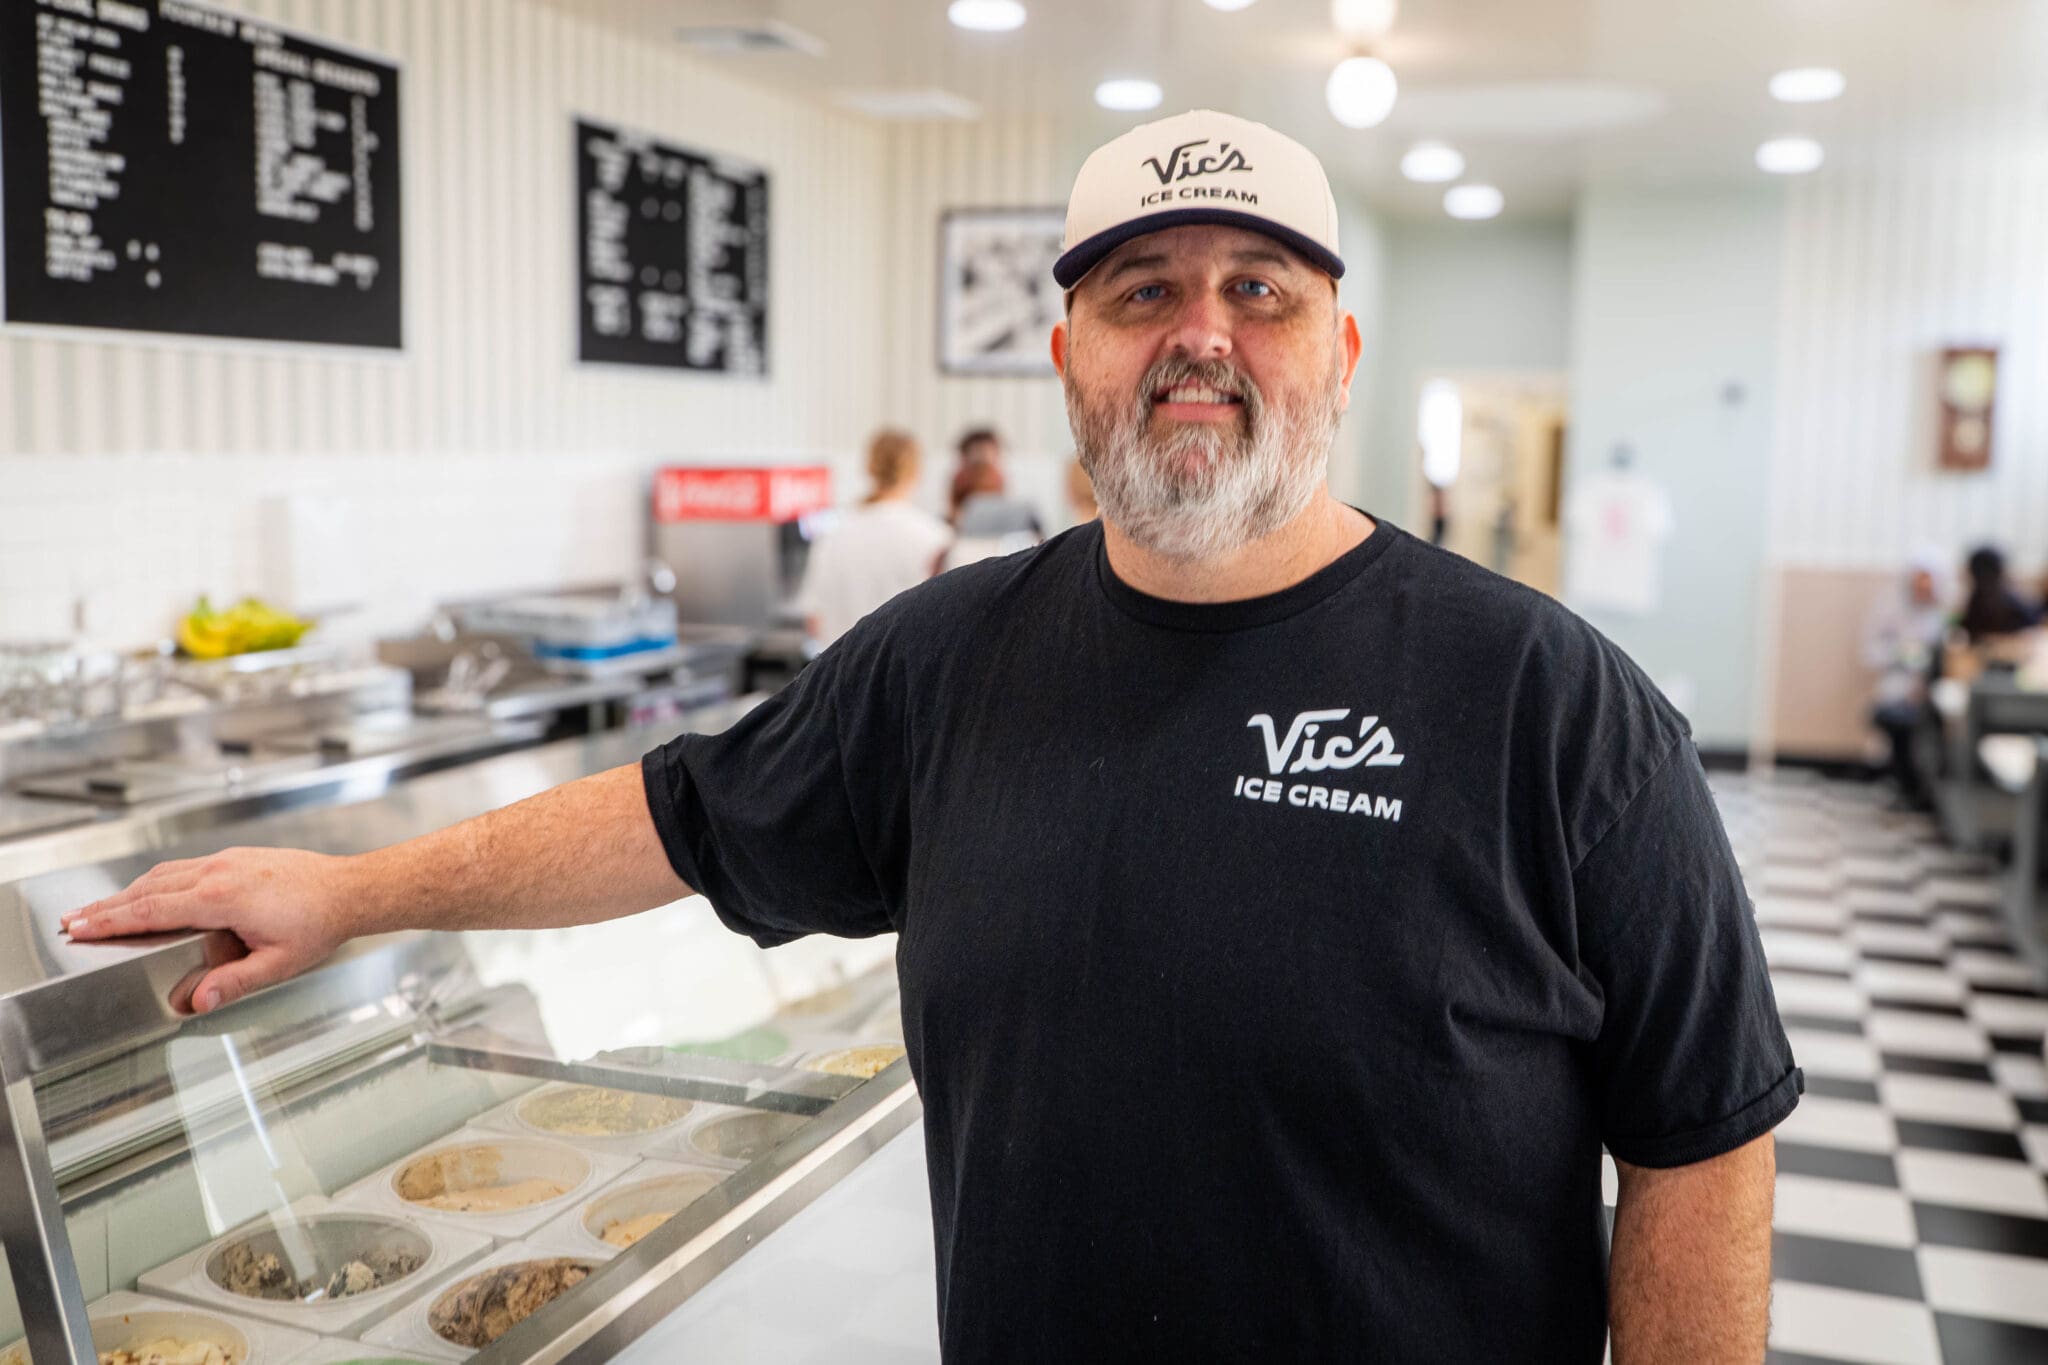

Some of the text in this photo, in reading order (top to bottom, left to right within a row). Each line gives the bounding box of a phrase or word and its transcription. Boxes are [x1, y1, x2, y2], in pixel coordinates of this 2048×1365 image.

[1141, 139, 1253, 185] Vic's
[1141, 187, 1258, 207] ICE CREAM
[1247, 708, 1405, 775] Vic's
[1234, 775, 1403, 822] ICE CREAM
